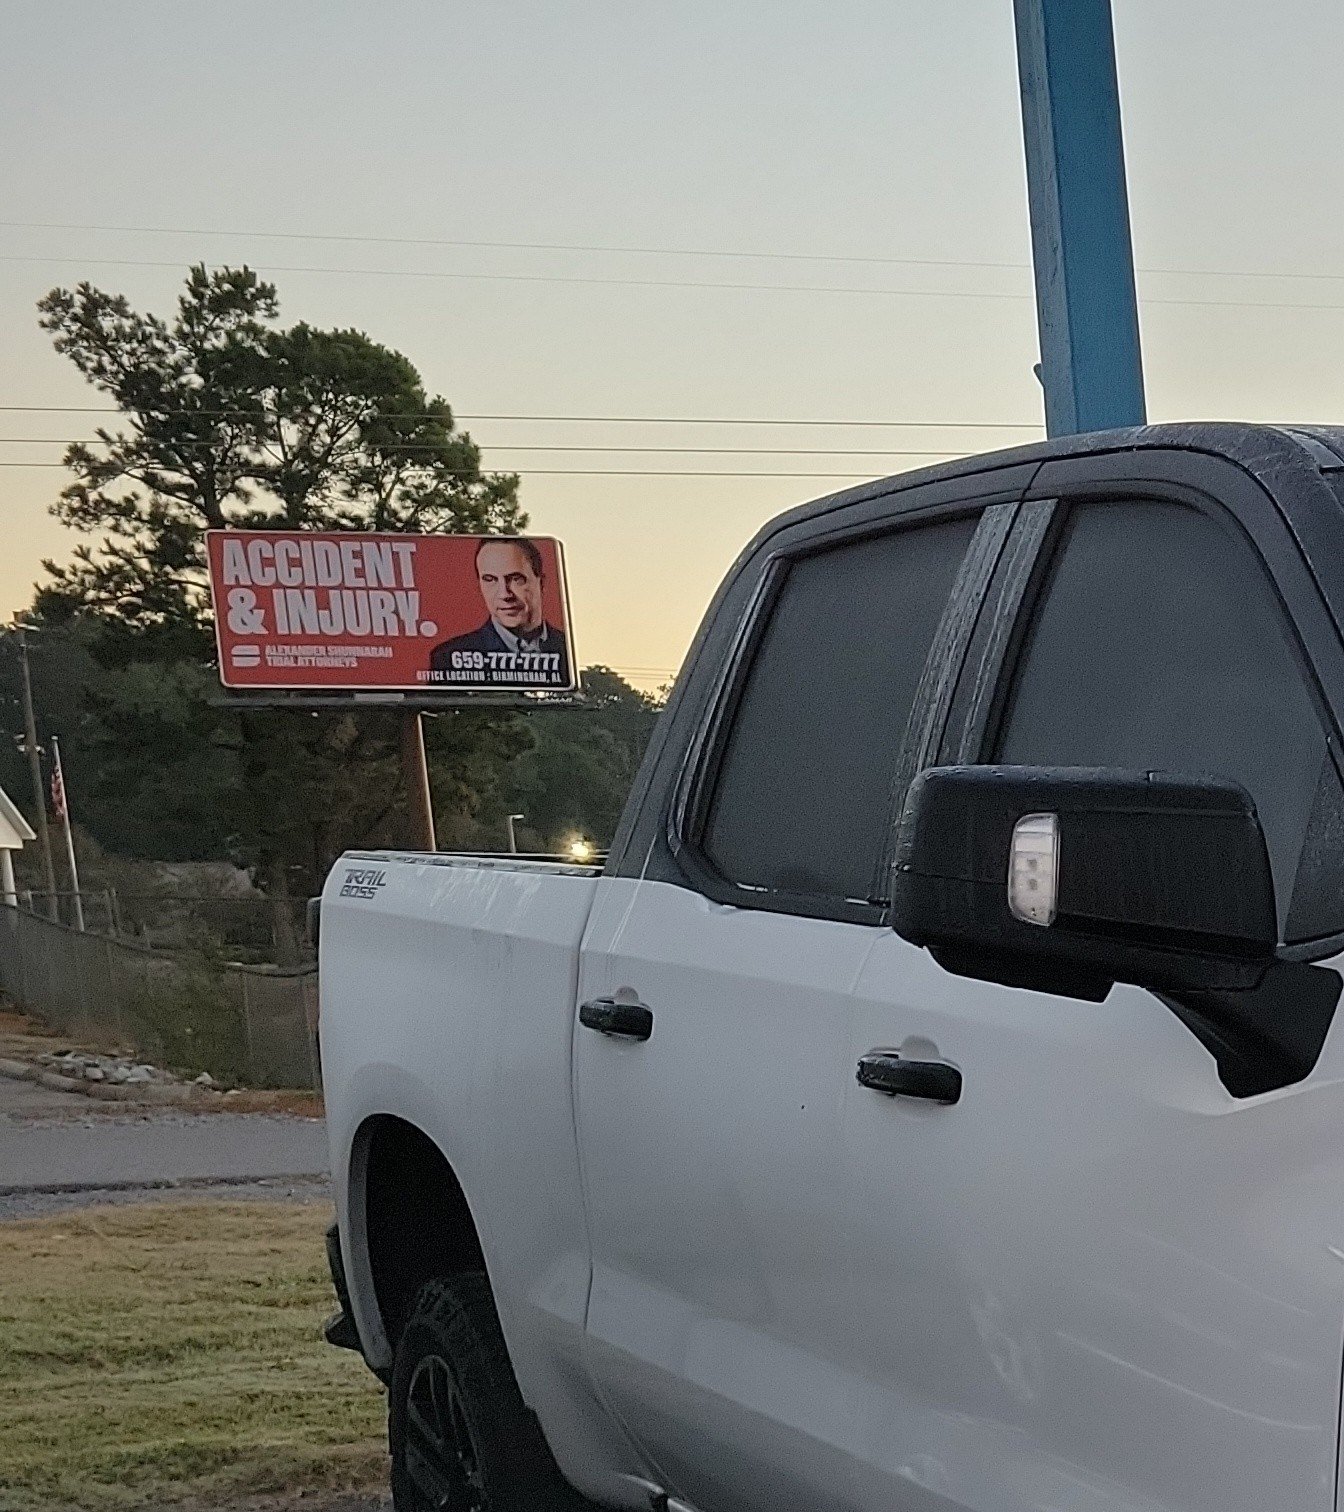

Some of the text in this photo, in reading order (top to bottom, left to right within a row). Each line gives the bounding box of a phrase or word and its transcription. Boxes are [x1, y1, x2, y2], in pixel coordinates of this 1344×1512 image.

[223, 539, 416, 588] ACCIDENT
[227, 588, 438, 637] & INJURY.
[451, 651, 560, 671] 659-777-7777
[416, 670, 444, 681] OFFICE
[446, 670, 485, 682] LOCATION
[345, 869, 386, 886] TRAIL
[339, 885, 378, 899] BOSS
